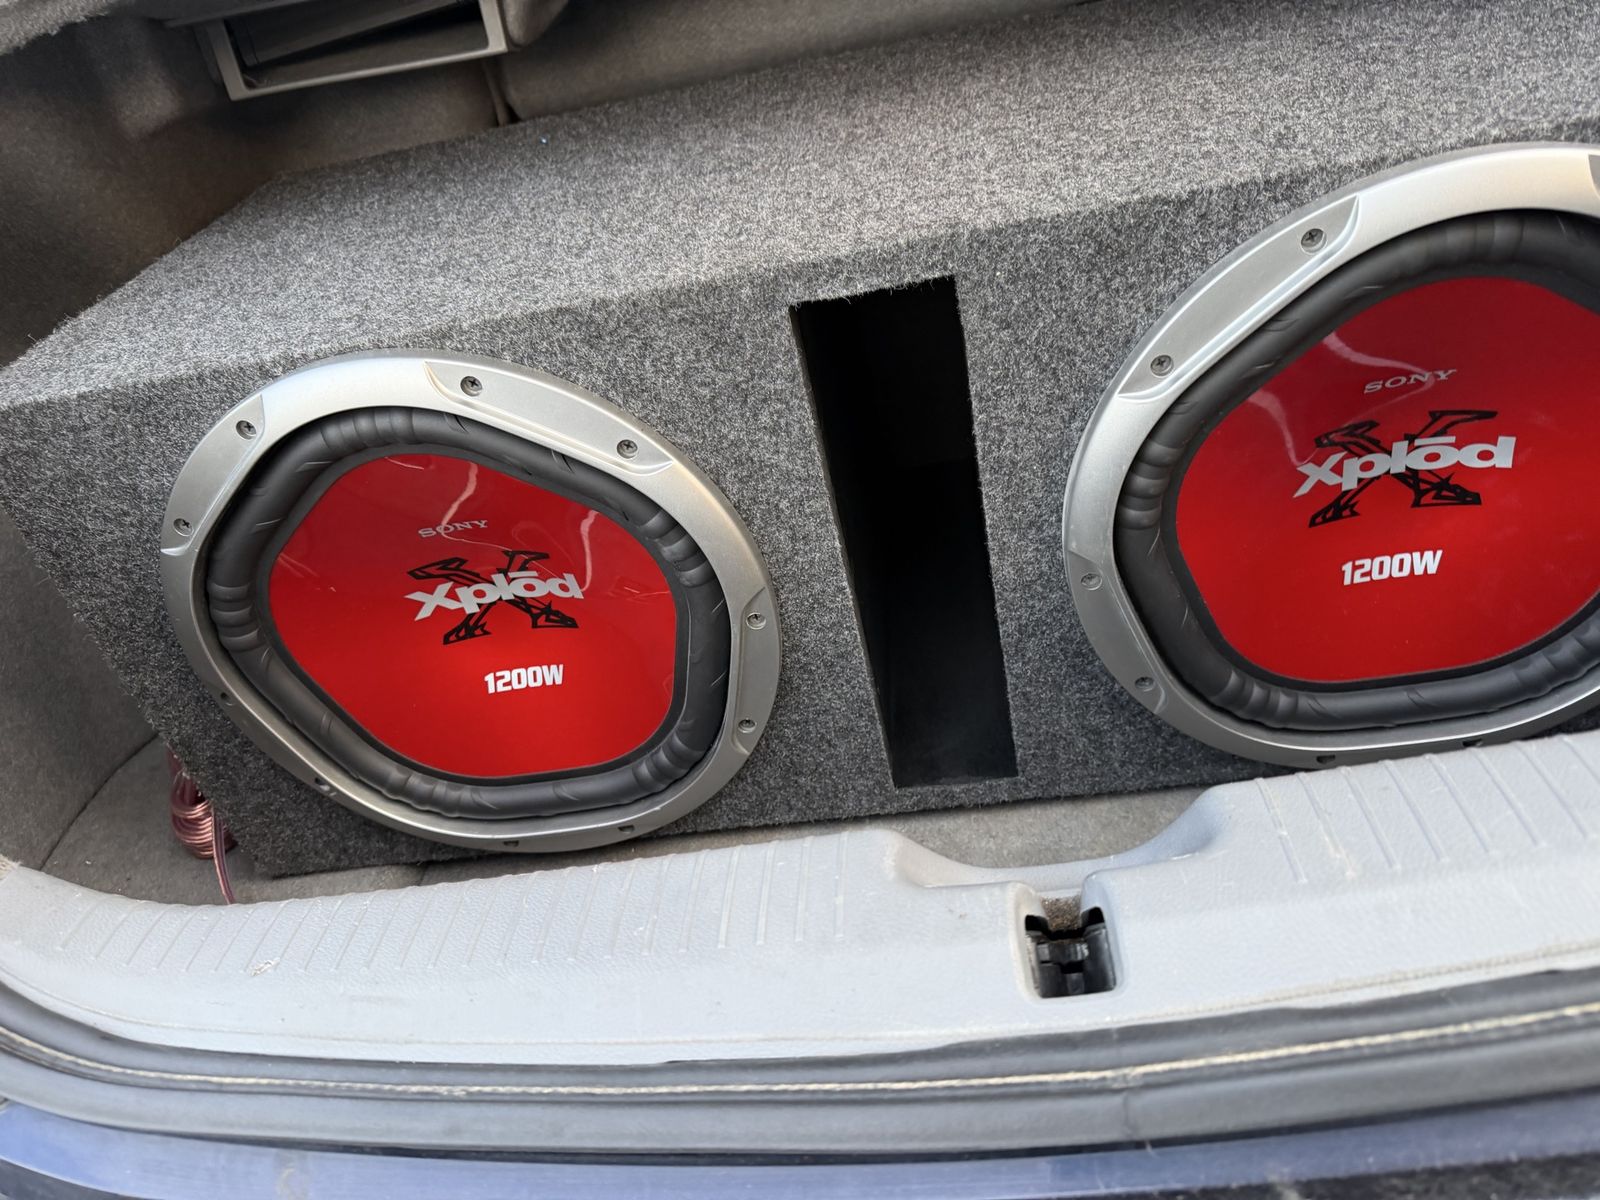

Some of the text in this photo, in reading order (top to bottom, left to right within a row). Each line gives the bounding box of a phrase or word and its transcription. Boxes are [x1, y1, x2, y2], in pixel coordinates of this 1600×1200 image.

[1364, 369, 1457, 394] SONY
[418, 520, 488, 537] SONY
[1341, 549, 1443, 586] 1200W
[484, 664, 564, 694] 1200W
